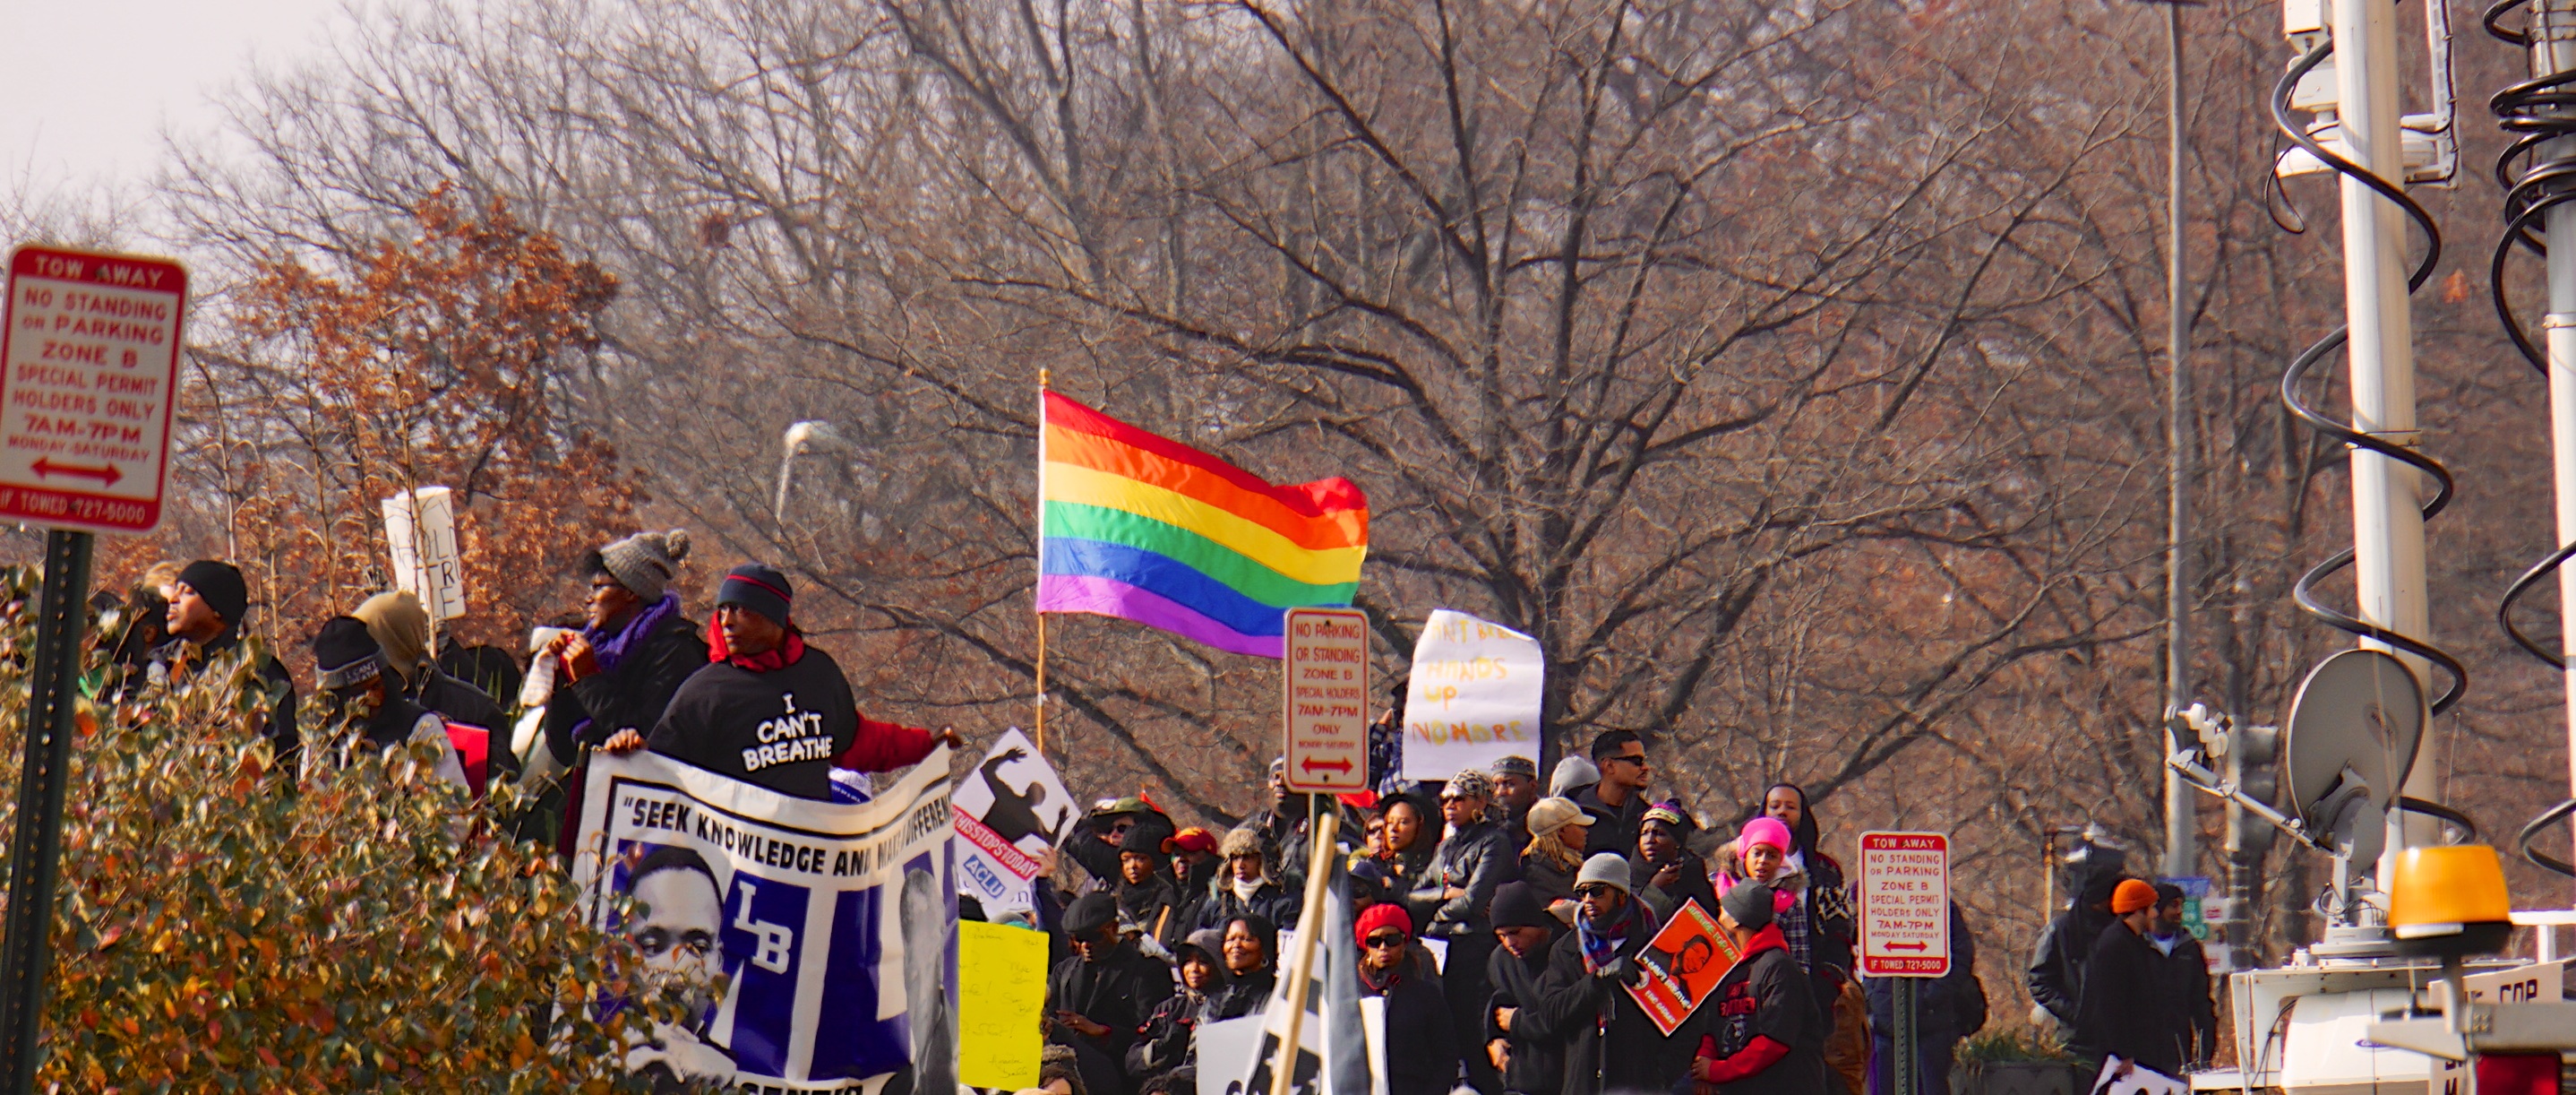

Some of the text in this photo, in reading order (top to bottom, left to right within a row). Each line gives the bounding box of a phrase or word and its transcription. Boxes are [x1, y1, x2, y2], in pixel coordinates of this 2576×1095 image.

[36, 254, 165, 288] TOW AWAY
[24, 287, 167, 322] NO STANDING
[22, 315, 166, 346] OR PARKING
[42, 341, 138, 368] ZONE B
[16, 364, 159, 397] SPECIAL PERMIT
[13, 389, 155, 421] HOLDERS ONLY
[23, 412, 142, 444] 7AM-7PM
[21, 491, 68, 516] TOWED
[74, 496, 147, 525] 727-5000
[1295, 623, 1361, 640] NO PARKING
[1295, 647, 1361, 664] OR STANDING
[1303, 668, 1353, 681] ZONE B
[1425, 656, 1508, 682] HANDS
[1295, 686, 1361, 700] SPECIAL HOLDERS
[781, 693, 795, 714] I
[1298, 703, 1359, 718] 7AM-7PM
[757, 711, 822, 744] CAN'T
[1312, 723, 1342, 736] ONLY
[741, 736, 833, 772] BREATHE
[697, 811, 827, 875] KNOWLEDGE
[833, 847, 872, 877] AND
[1873, 838, 1936, 849] TOW AWAY
[1870, 854, 1940, 865] NO STANDING
[965, 858, 1005, 897] ACLU
[1870, 867, 1940, 876] OR PARKING
[1881, 881, 1928, 891] ZONE B
[1871, 894, 1940, 905] SPECIAL PERMIT
[1871, 908, 1940, 918] HOLDERS ONLY
[1876, 920, 1934, 930] 7AM-7PM
[1870, 960, 1942, 970] IF TOWED 727-5000
